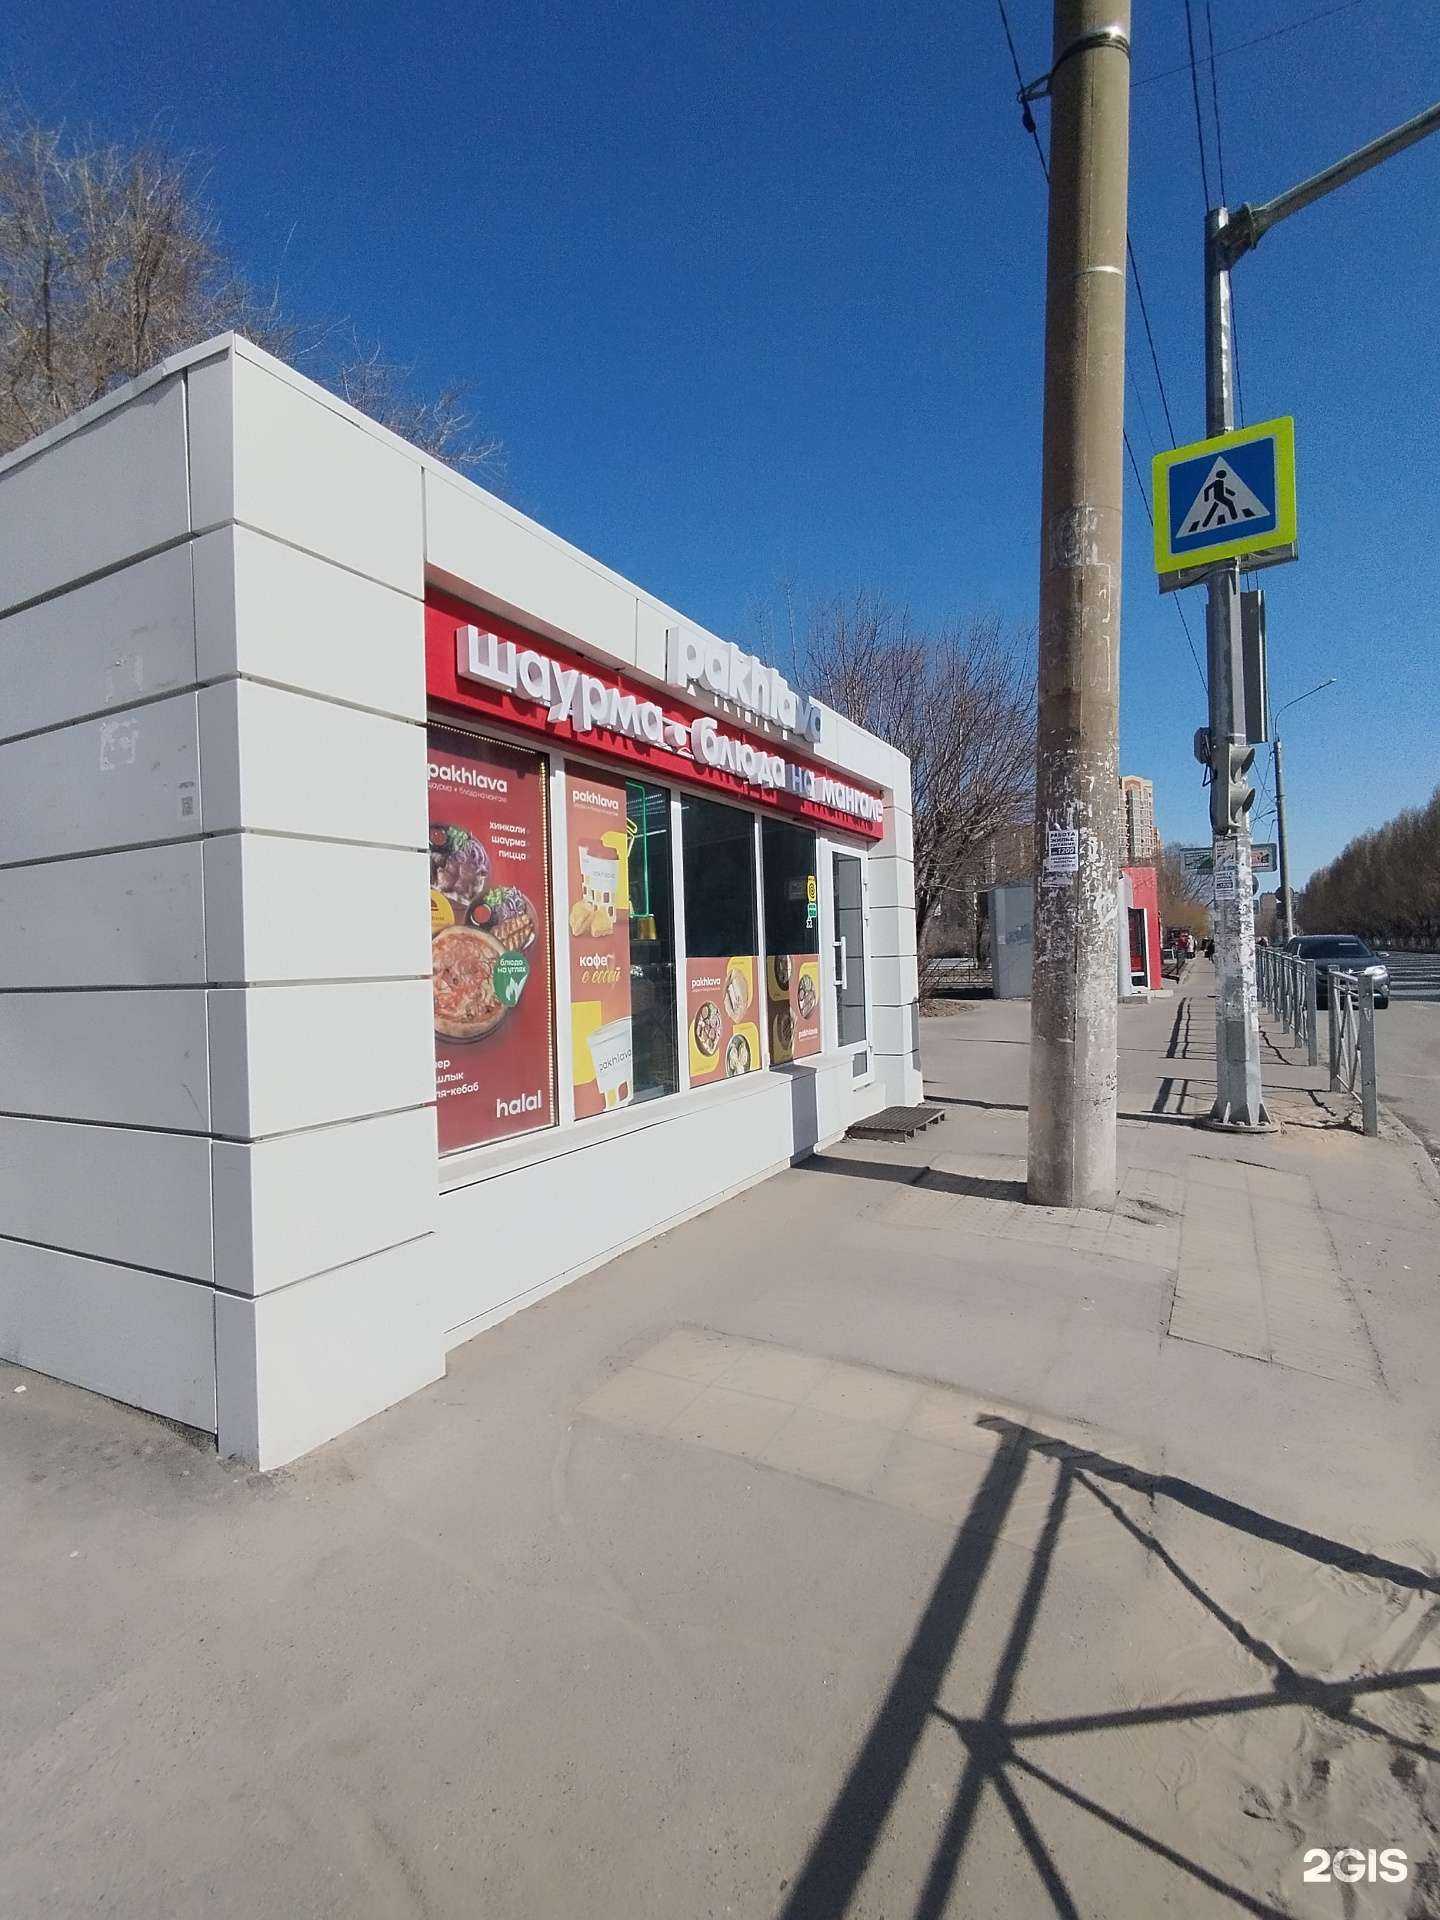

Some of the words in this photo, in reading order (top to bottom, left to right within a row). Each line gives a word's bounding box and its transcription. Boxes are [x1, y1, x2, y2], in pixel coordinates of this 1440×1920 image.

[667, 627, 821, 743] pakhlava
[456, 624, 662, 741] шаурма
[691, 716, 785, 788] блюда
[786, 764, 816, 798] на
[815, 776, 883, 822] мангале
[427, 763, 507, 793] pakhlava
[572, 790, 618, 810] pakhlava
[489, 821, 526, 834] хинкали
[491, 836, 526, 847] шаурма
[498, 850, 526, 861] пицца
[500, 958, 523, 967] блюда
[579, 953, 608, 970] кофе
[496, 1090, 542, 1118] halal
